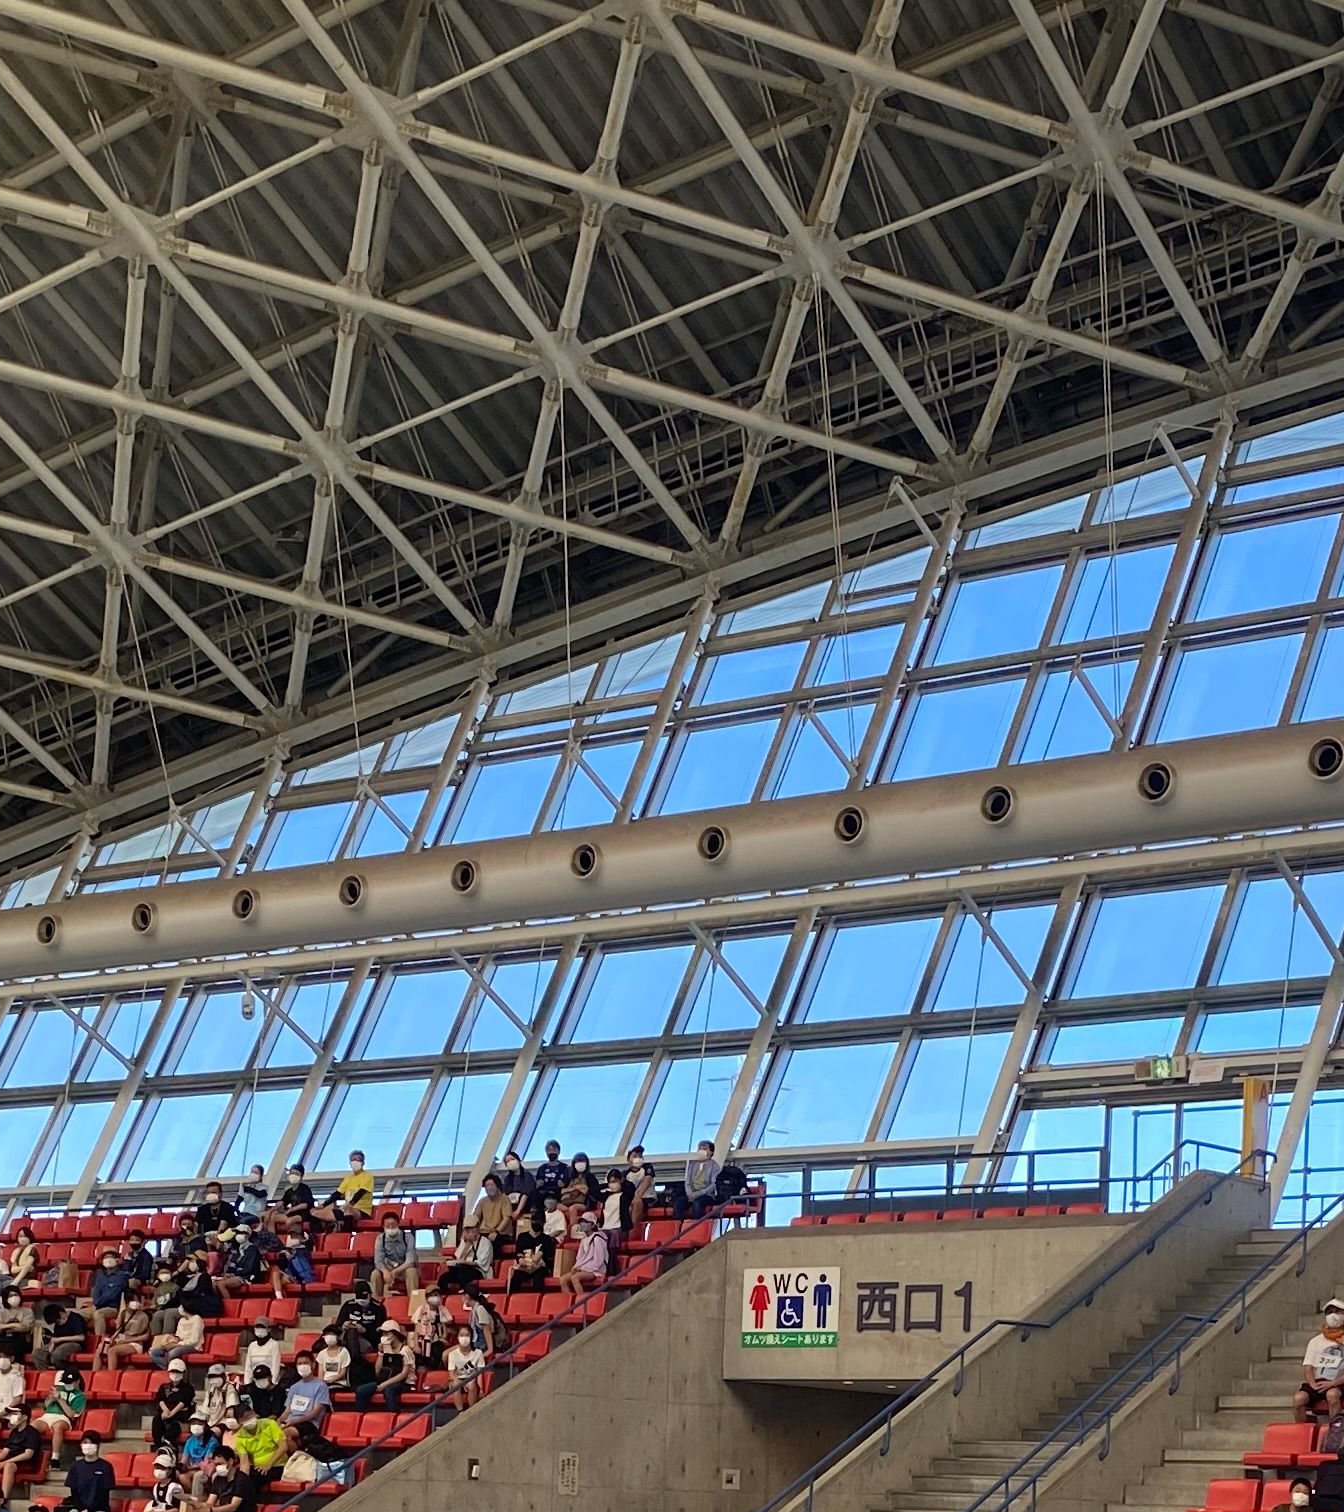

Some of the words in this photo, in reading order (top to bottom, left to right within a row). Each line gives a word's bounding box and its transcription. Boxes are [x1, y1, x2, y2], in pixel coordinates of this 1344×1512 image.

[1260, 1081, 1268, 1102] A
[773, 1273, 808, 1294] WC
[856, 1281, 973, 1333] 西口1
